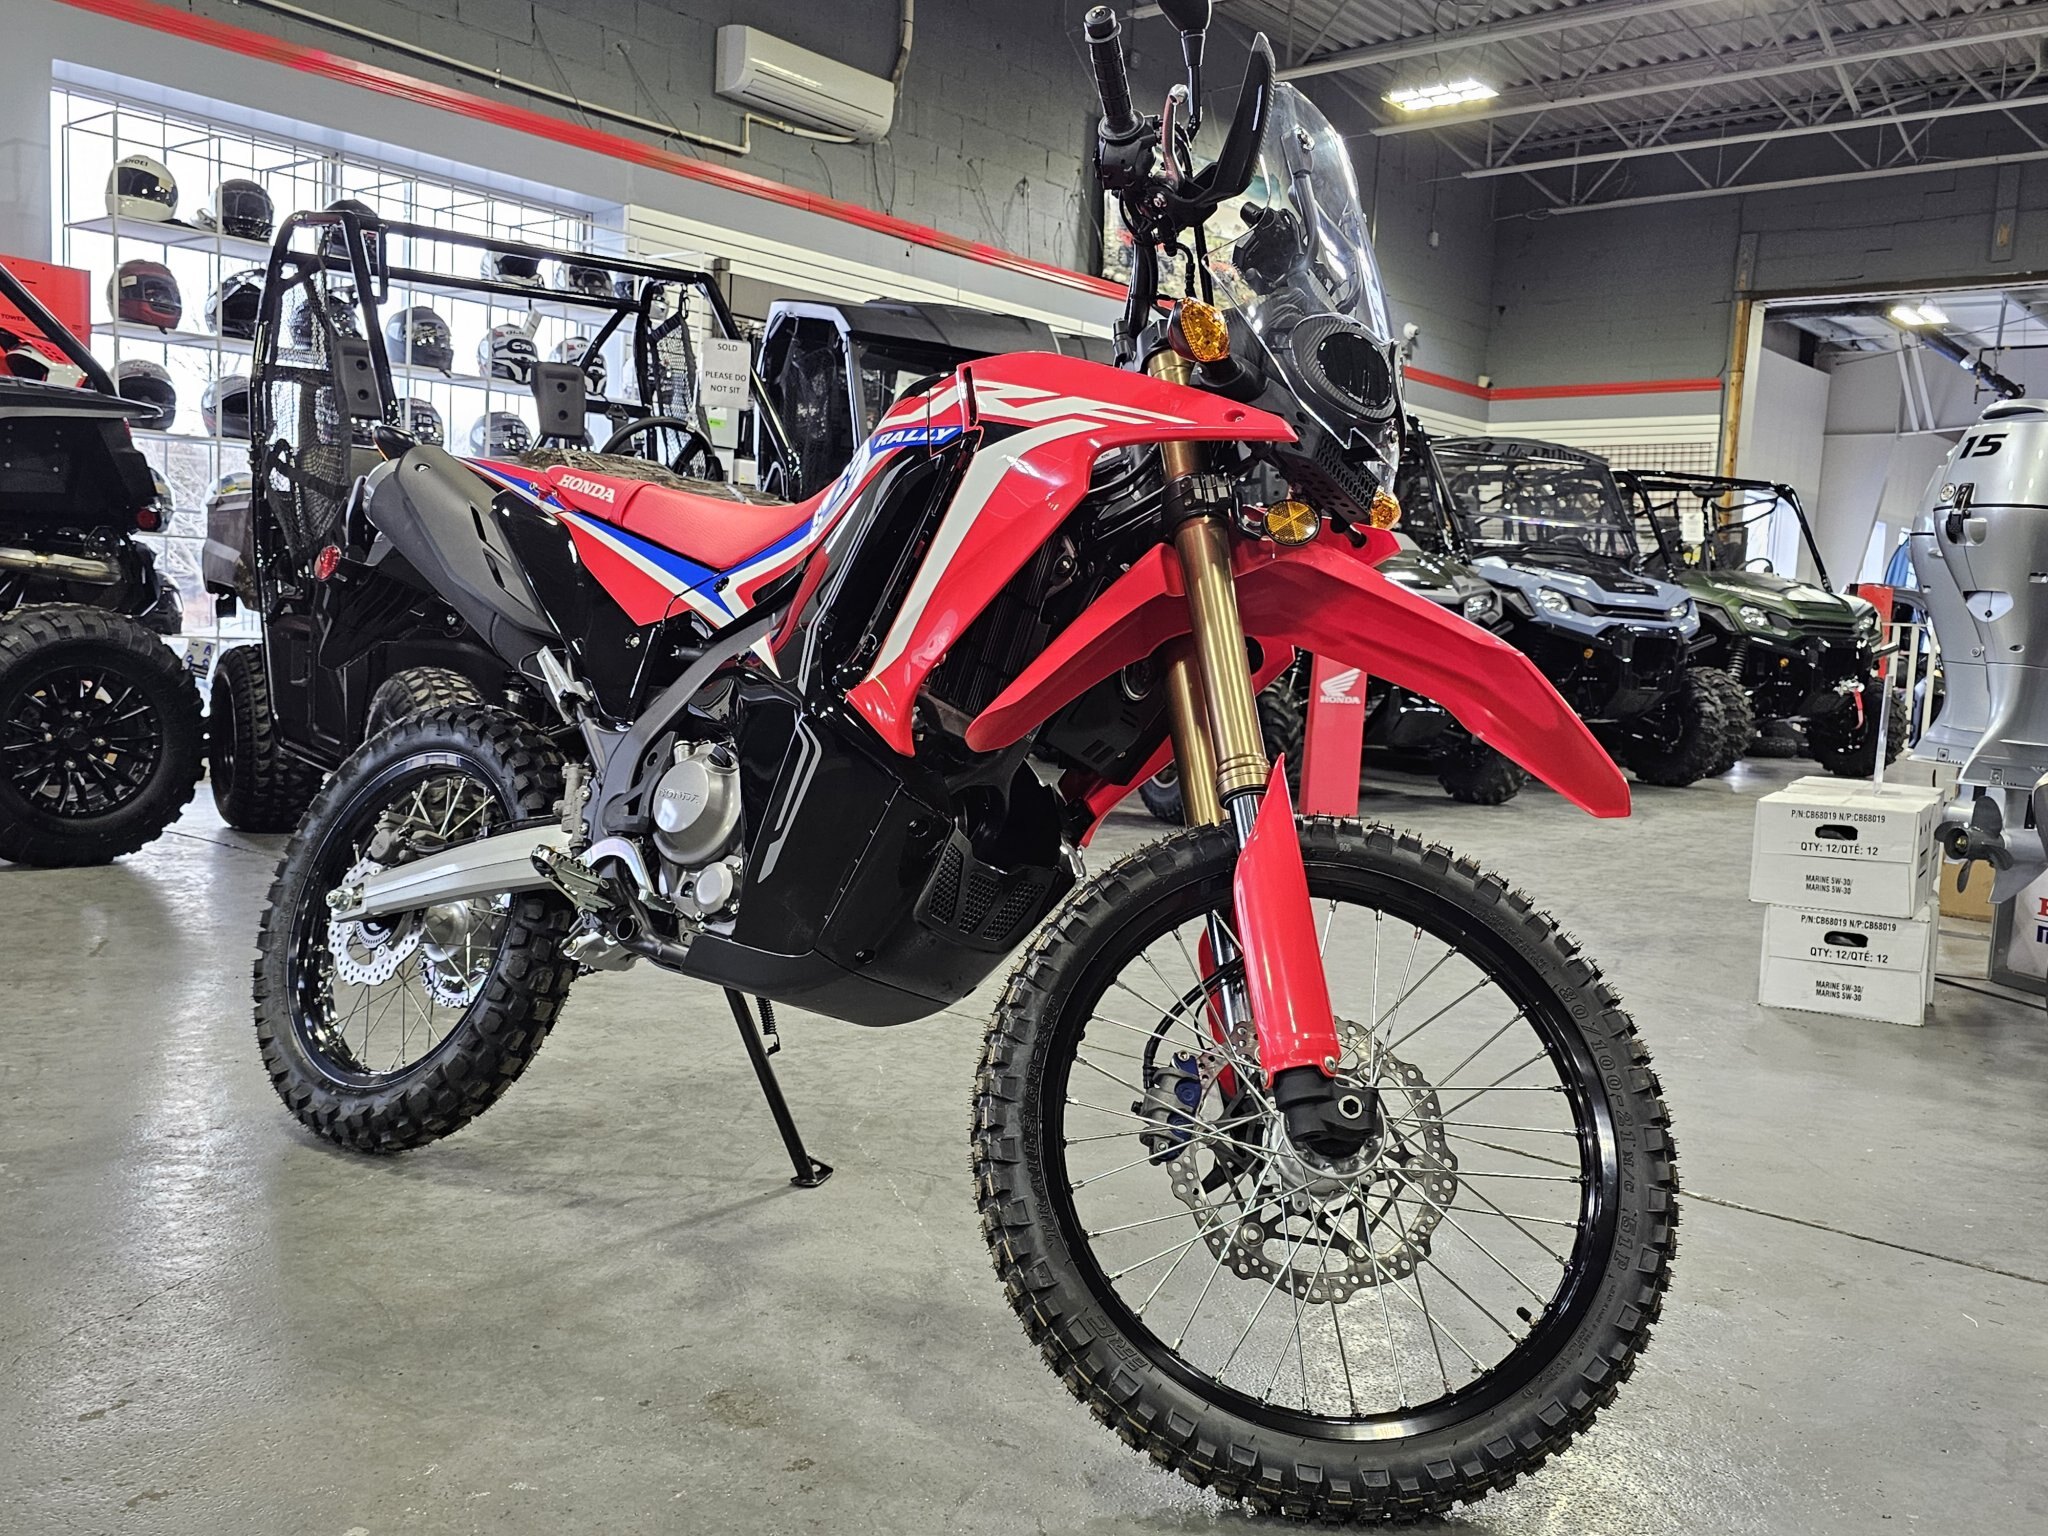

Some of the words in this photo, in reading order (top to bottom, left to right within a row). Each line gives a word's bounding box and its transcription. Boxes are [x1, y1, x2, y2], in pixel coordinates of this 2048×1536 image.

[717, 343, 738, 352] SOLD
[705, 370, 733, 381] PLEASE
[735, 374, 747, 382] DO
[710, 384, 726, 393] NOT
[729, 386, 741, 394] SIT
[874, 427, 958, 449] RALLY
[1959, 432, 2010, 460] 15
[557, 474, 615, 504] HONDA
[1320, 695, 1361, 705] HONDA
[1791, 809, 1837, 820] P/N:CB68019
[1838, 812, 1886, 823] N/P:CB68019
[1801, 842, 1823, 853] QTY:
[1867, 847, 1879, 856] 12
[1806, 875, 1830, 885] MARINE
[1806, 883, 1830, 893] MARINS
[1831, 885, 1851, 895] 5W-30
[1801, 915, 1848, 928] P/N:CB68019
[1850, 919, 1897, 931] N/P:CB68019
[1810, 947, 1833, 958] QTY:
[1877, 954, 1889, 964] 12
[1816, 980, 1840, 991] MARINE
[1816, 989, 1840, 999] MARINS
[1842, 991, 1862, 1001] 5W-30
